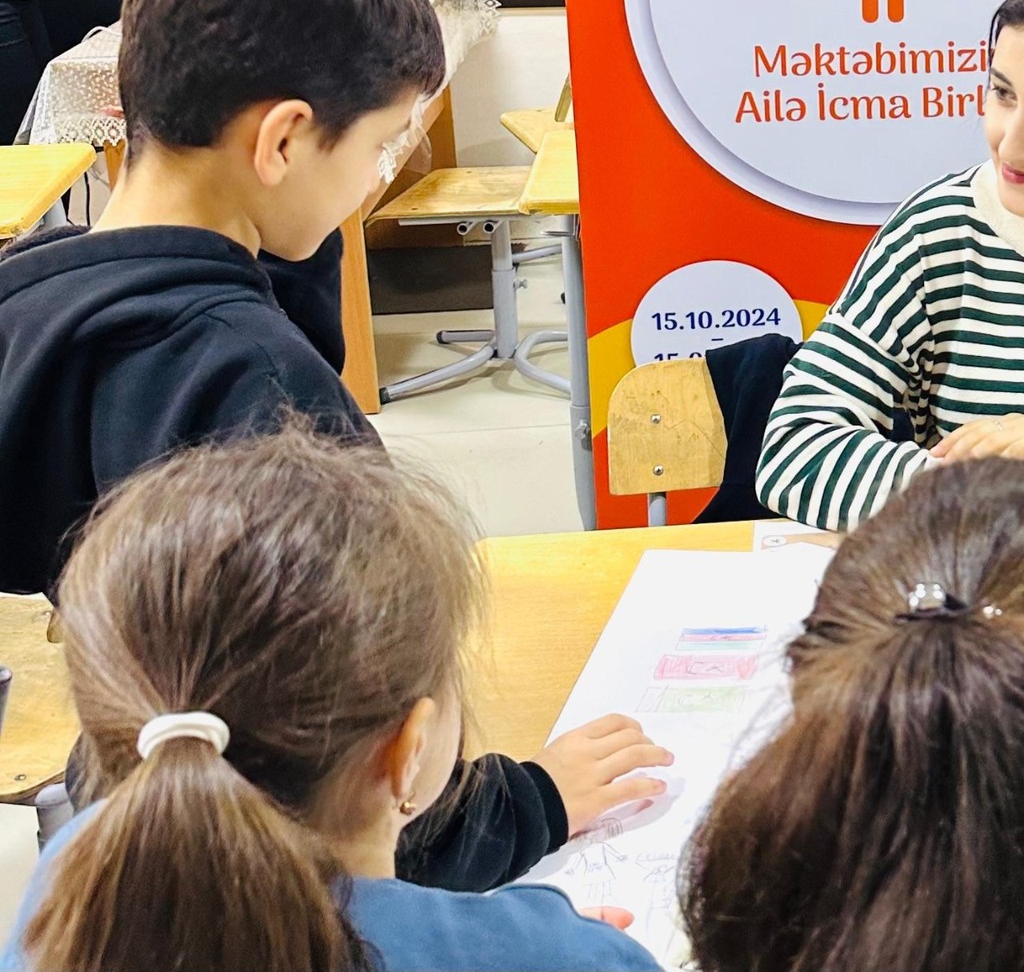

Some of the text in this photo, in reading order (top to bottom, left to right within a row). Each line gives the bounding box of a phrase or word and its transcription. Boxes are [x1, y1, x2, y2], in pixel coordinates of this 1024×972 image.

[753, 40, 989, 76] Məktəbimizi
[735, 82, 986, 121] Ailə İcma Birl
[650, 307, 782, 331] 15.10.2024
